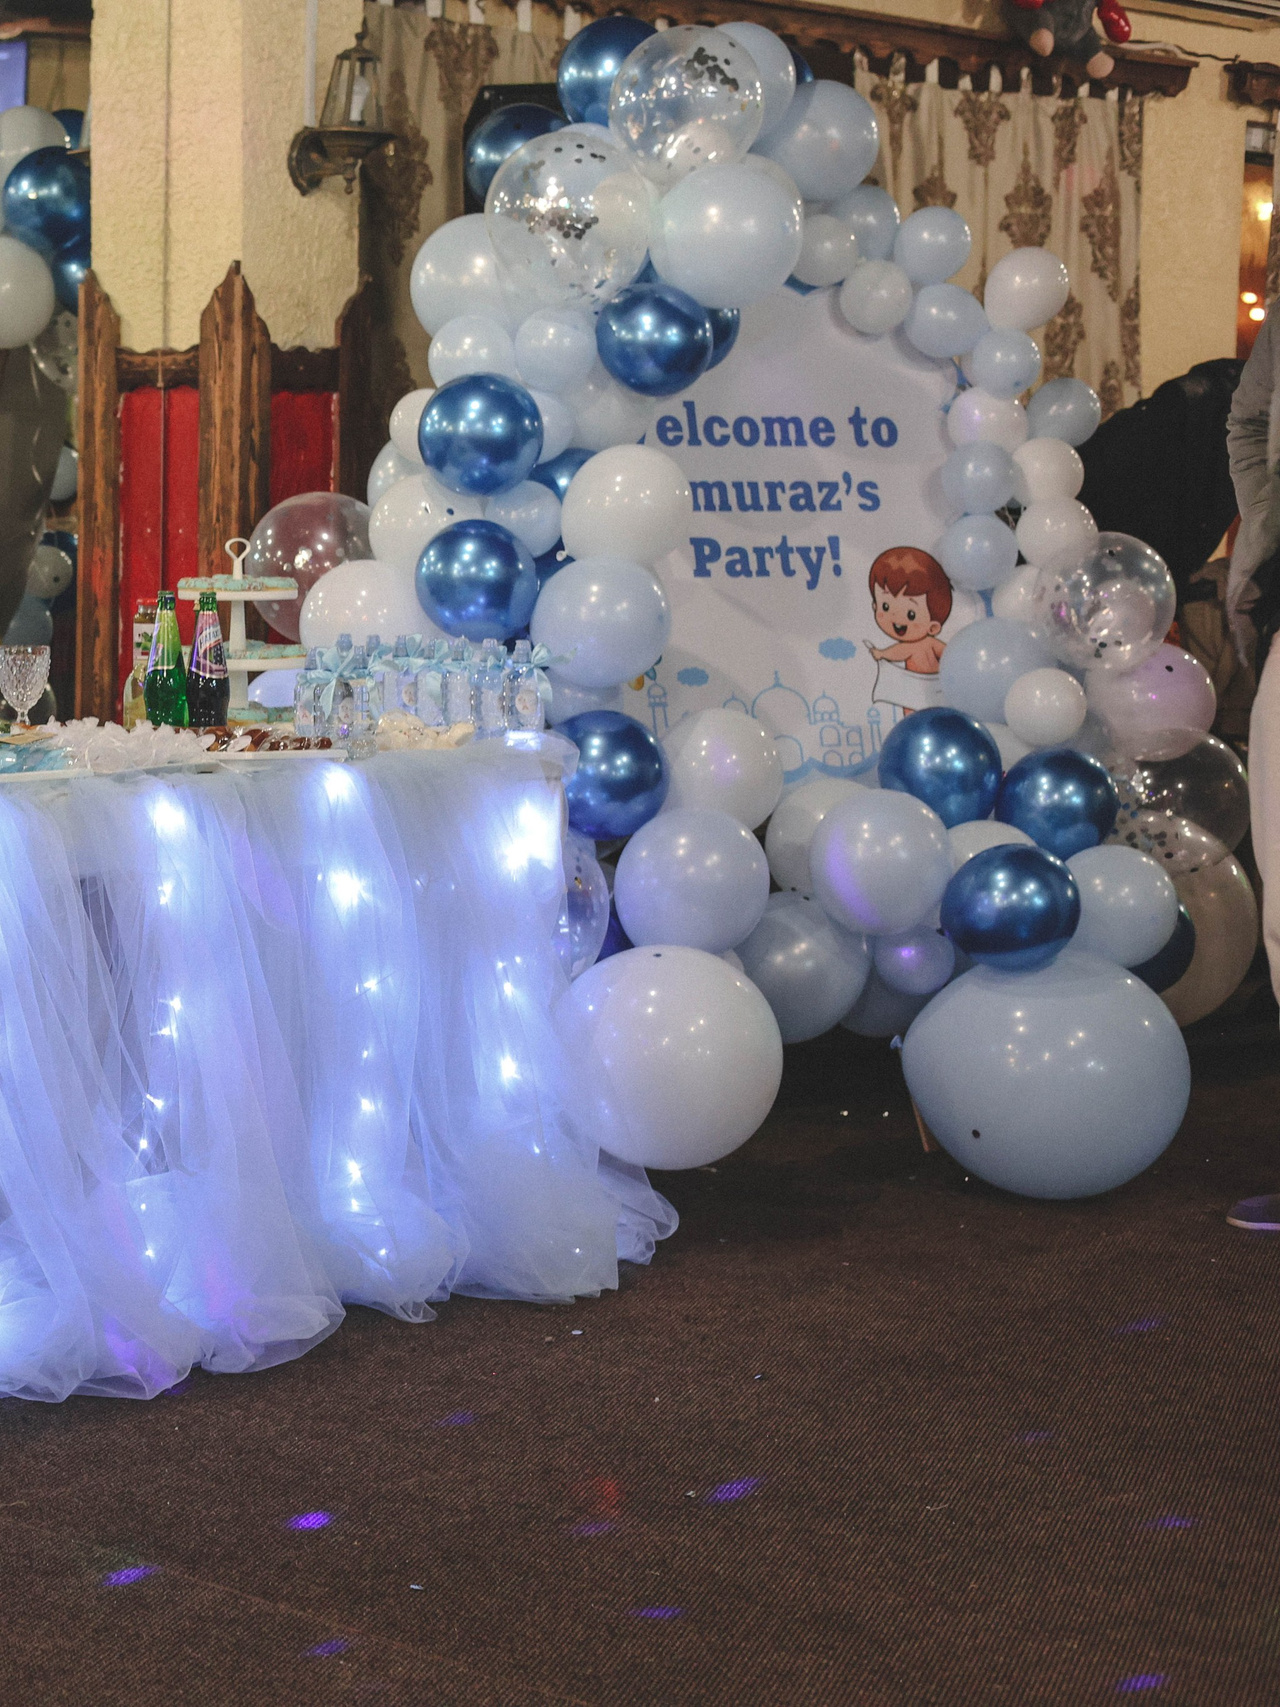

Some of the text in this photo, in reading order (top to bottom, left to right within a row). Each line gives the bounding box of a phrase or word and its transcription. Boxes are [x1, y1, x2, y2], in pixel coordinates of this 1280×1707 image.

[637, 401, 899, 447] elcome to
[689, 471, 881, 512] muraz's
[690, 535, 842, 590] Party!
